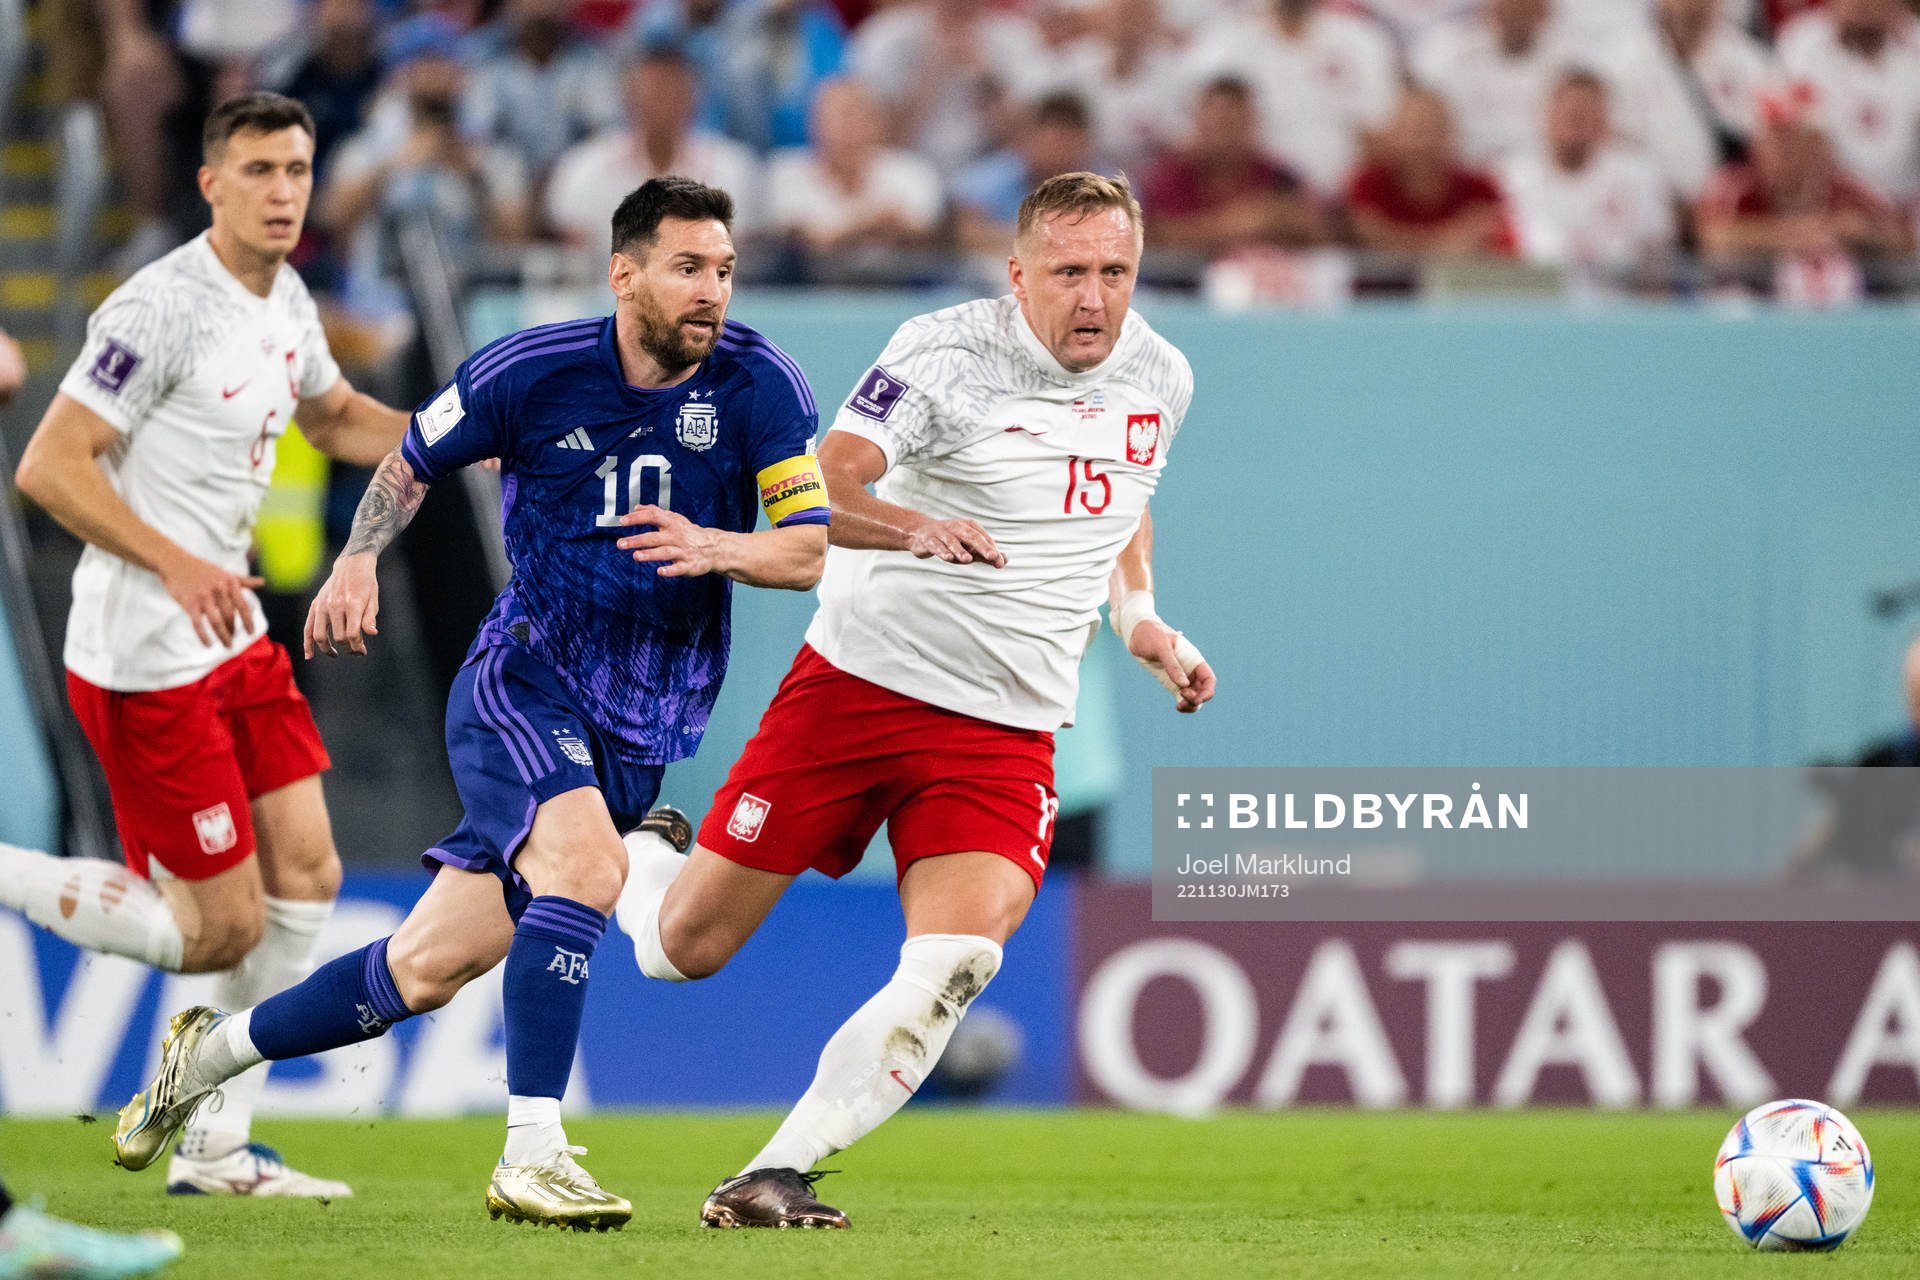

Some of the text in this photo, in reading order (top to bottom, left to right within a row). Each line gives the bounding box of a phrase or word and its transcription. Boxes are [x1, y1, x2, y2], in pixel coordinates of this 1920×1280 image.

[685, 415, 709, 438] AFA
[594, 454, 672, 527] 10
[761, 472, 816, 499] PROTECT
[763, 481, 821, 508] CHILDREN
[1064, 455, 1116, 515] 15
[547, 946, 590, 984] AFA
[1079, 938, 1778, 1118] QATAR
